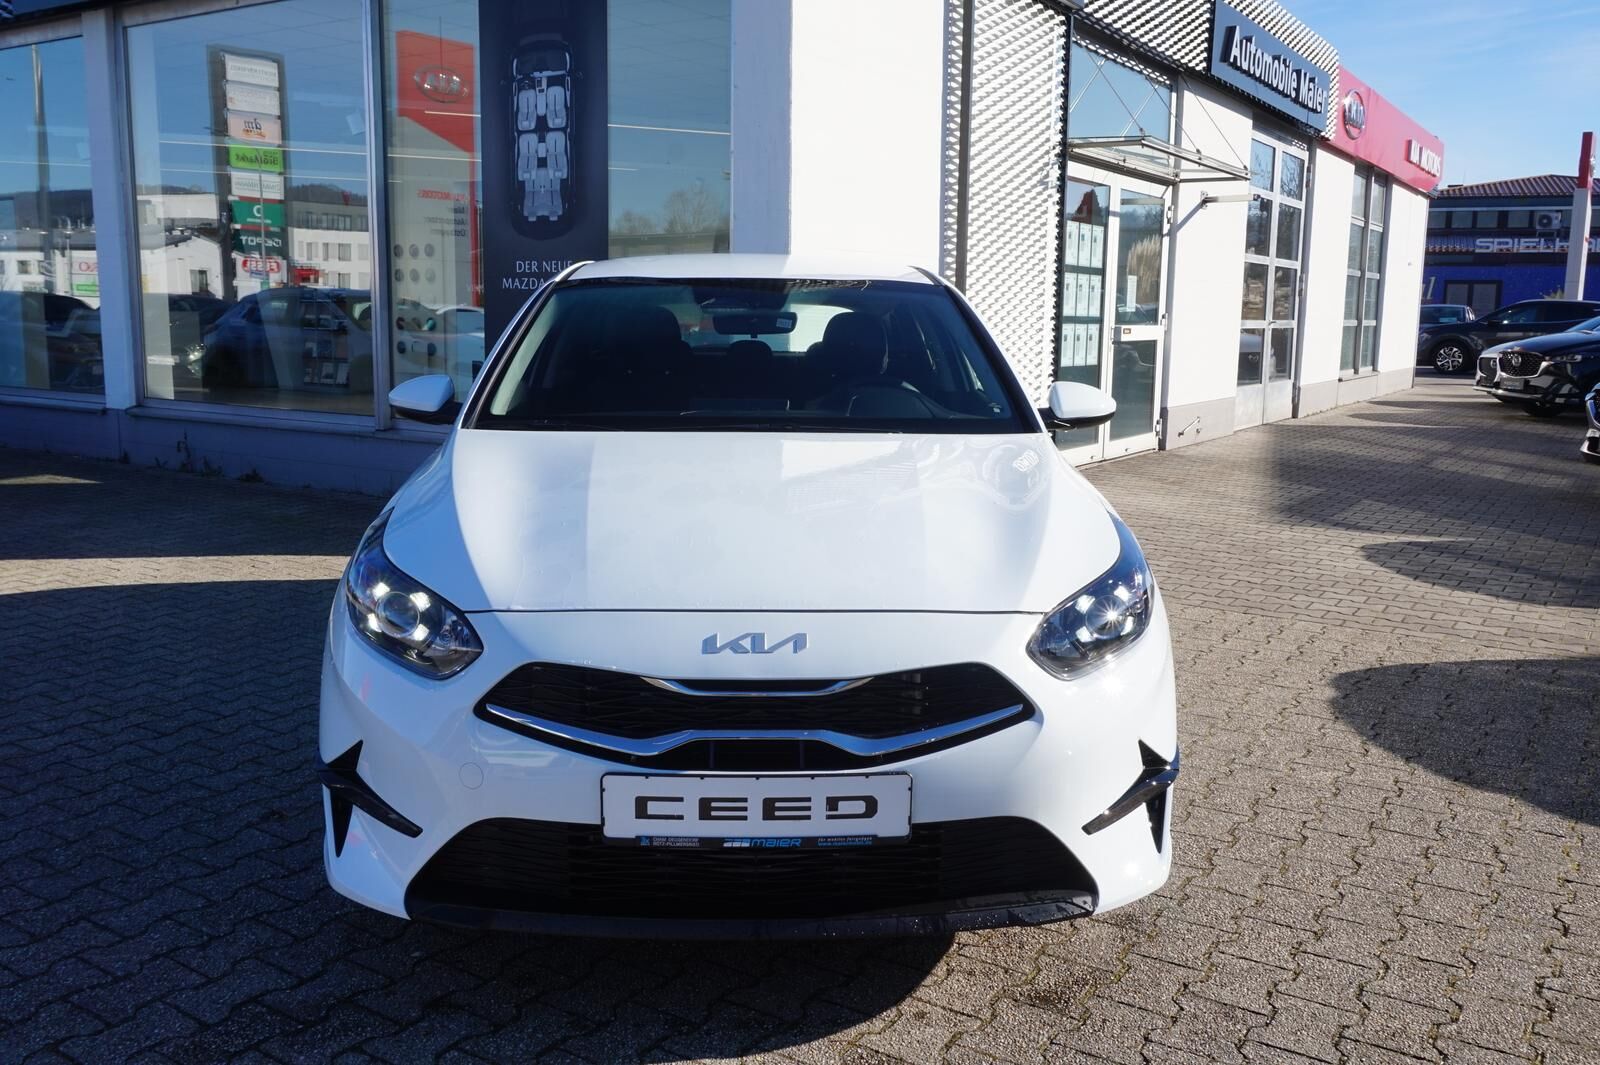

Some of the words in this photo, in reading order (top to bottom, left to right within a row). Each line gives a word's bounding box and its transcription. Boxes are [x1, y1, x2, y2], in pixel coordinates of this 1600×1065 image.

[1229, 25, 1298, 98] Automobile
[1300, 69, 1328, 114] Maier
[516, 261, 539, 273] DER
[502, 278, 546, 289] MAZDA
[635, 795, 878, 821] CEED
